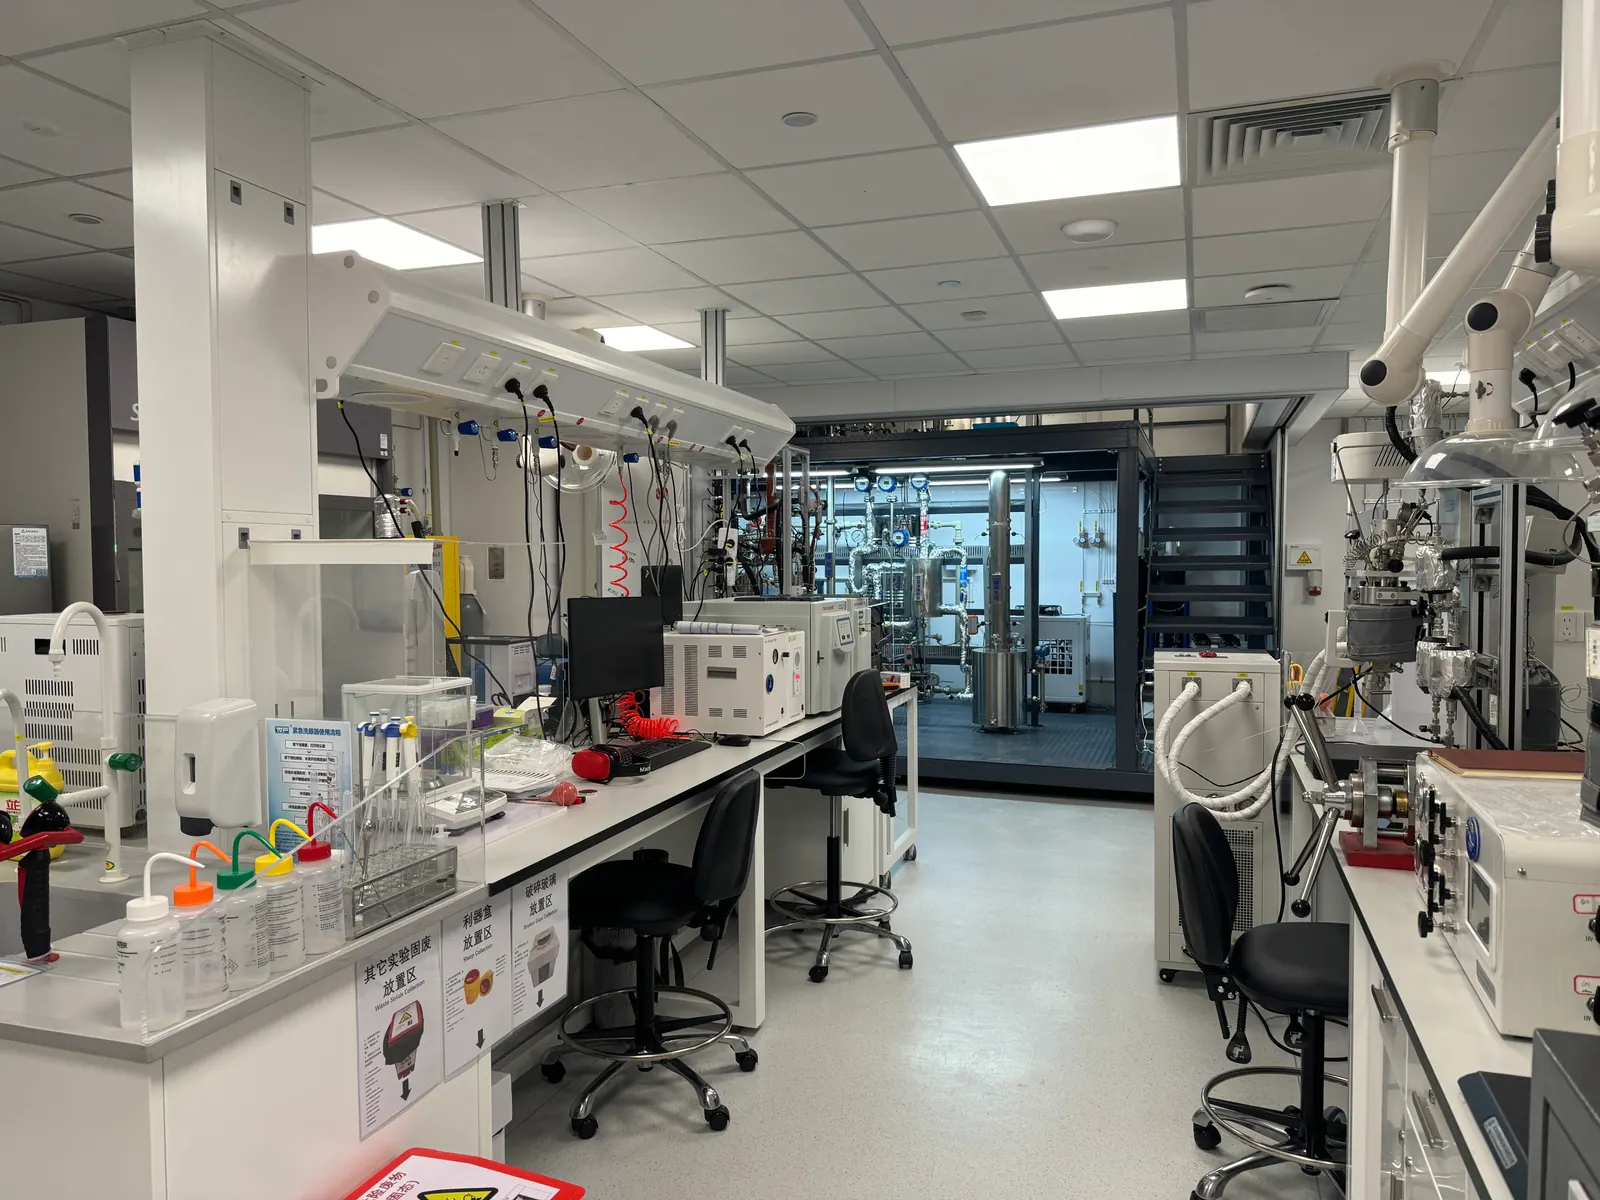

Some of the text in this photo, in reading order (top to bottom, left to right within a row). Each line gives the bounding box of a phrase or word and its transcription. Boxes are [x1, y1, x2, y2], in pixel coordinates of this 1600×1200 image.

[525, 872, 557, 899] 破碎玻璃
[463, 904, 493, 930] 利器盒
[529, 893, 553, 917] 放置区
[463, 924, 493, 951] 放置区
[364, 935, 432, 985] 其它实验固废
[463, 943, 494, 963] Sharp Collection
[383, 966, 418, 998] 放置区
[374, 980, 426, 1012] Waste Solids Collection
[362, 1172, 407, 1200] 险废物
